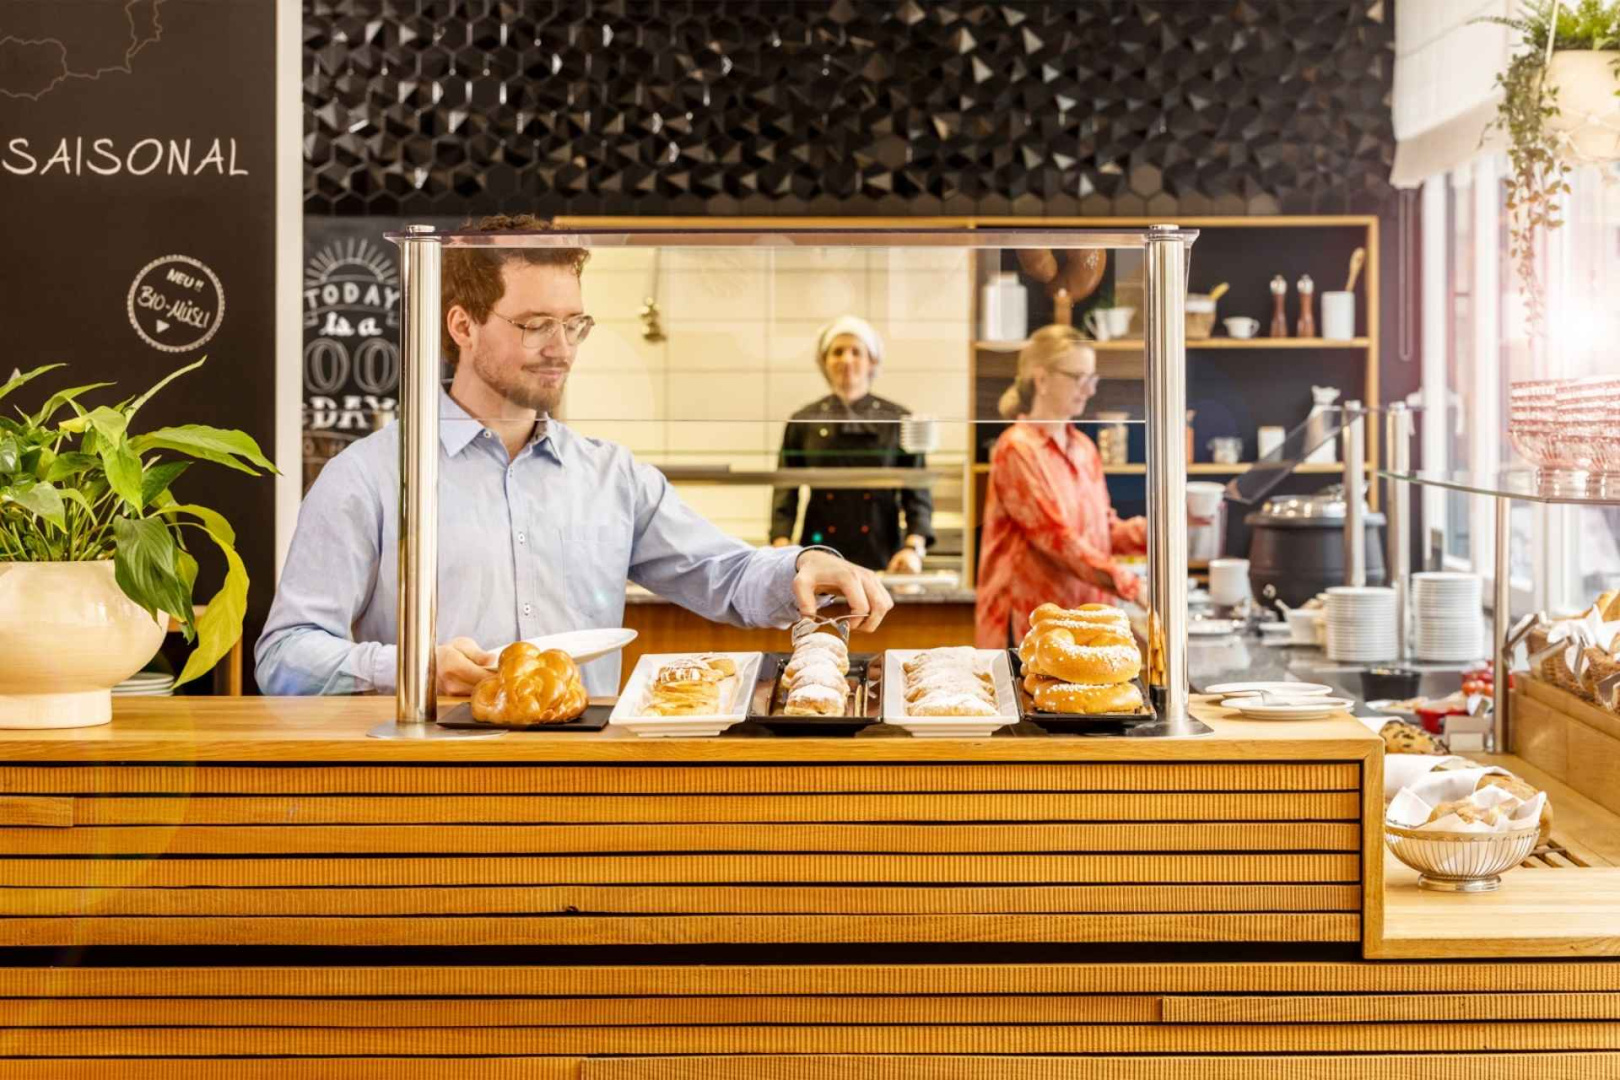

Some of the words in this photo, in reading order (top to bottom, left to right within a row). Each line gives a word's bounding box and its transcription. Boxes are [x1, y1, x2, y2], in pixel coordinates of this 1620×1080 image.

[2, 137, 249, 176] SAISONAL
[304, 282, 400, 310] TODAY
[319, 312, 355, 336] is
[358, 318, 383, 336] a
